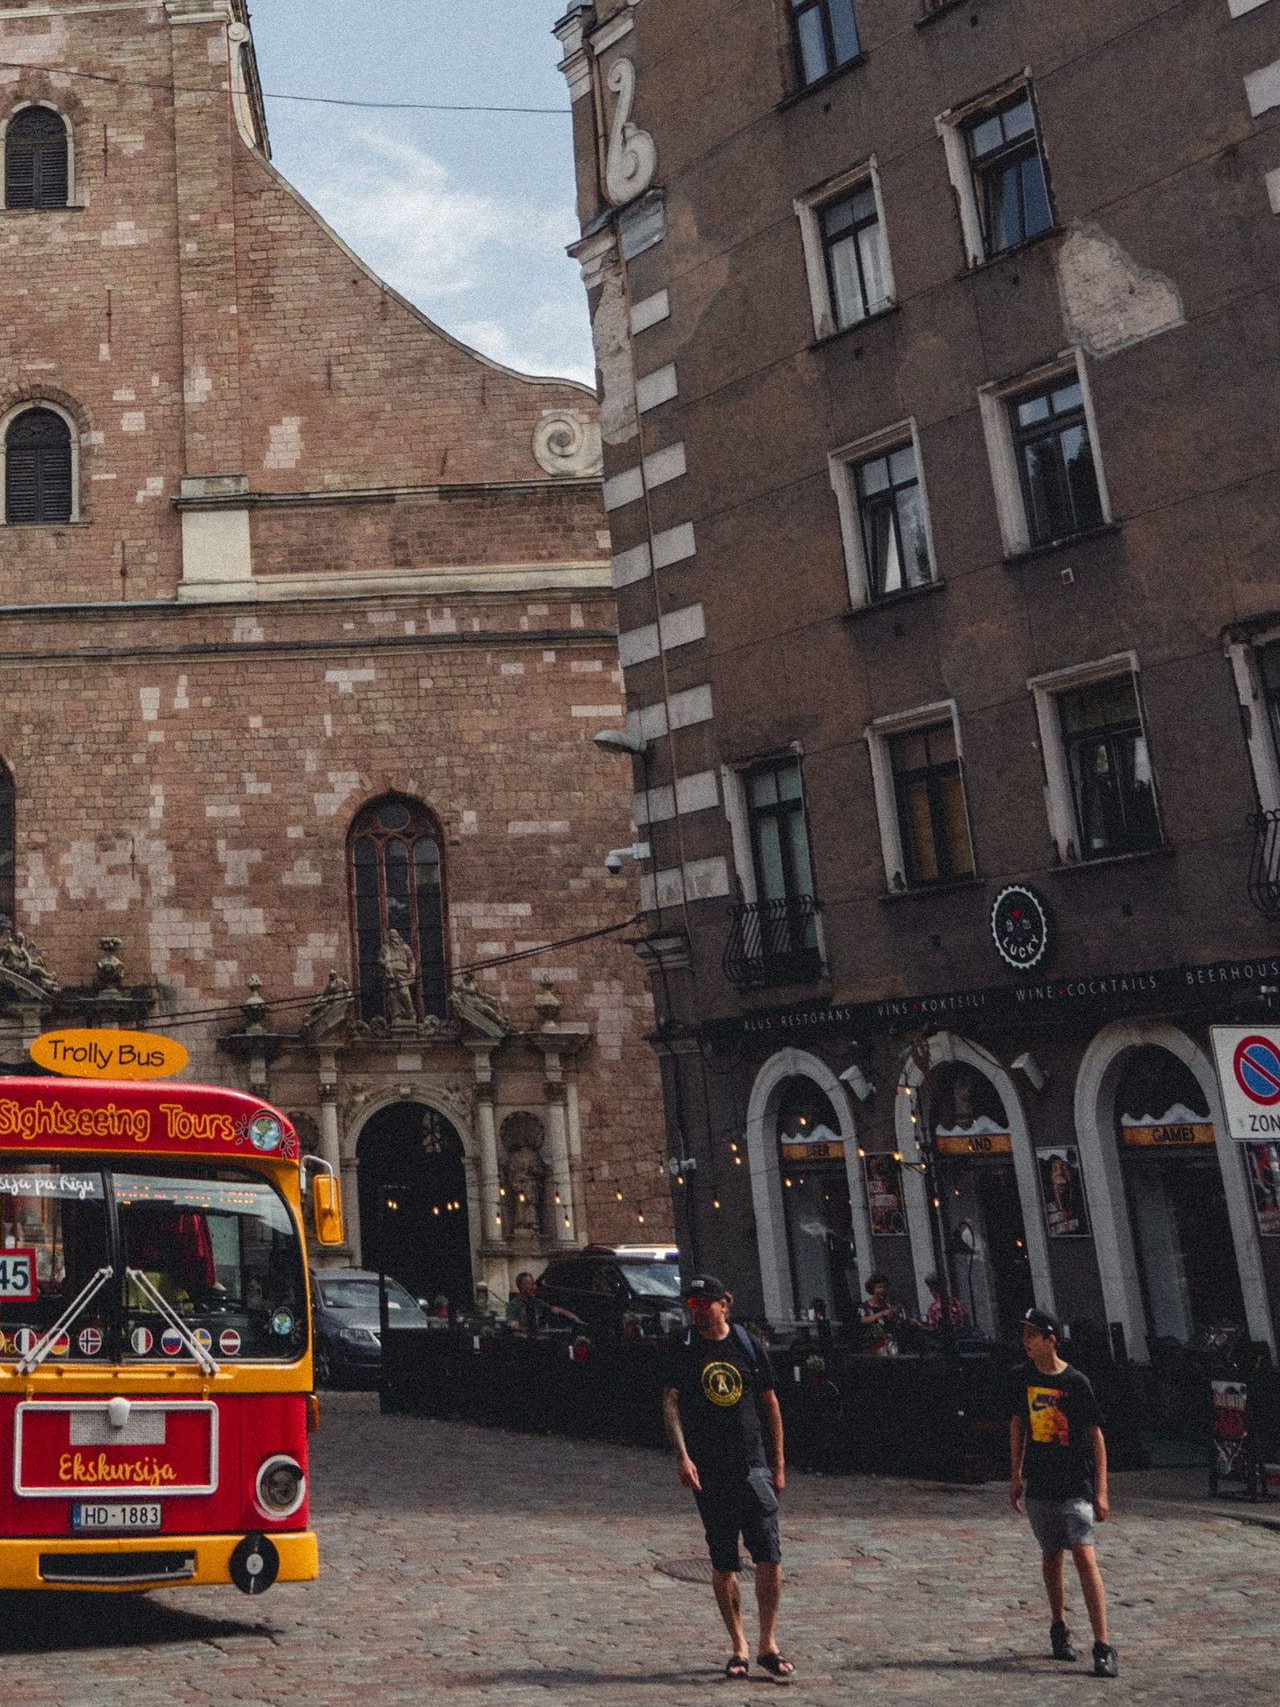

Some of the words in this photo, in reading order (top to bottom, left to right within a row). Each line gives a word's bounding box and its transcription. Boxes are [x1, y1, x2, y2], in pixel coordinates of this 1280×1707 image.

[1002, 934, 1039, 958] LUCKY
[1015, 986, 1053, 1002] WINE
[1066, 975, 1157, 997] COCKTAILS
[48, 1039, 113, 1070] Trolly
[118, 1044, 165, 1067] Bus
[159, 1104, 236, 1141] Tours
[1152, 1126, 1195, 1142] GAMES
[970, 1137, 992, 1152] AND
[35, 1178, 56, 1194] pa
[58, 1452, 178, 1488] Ekskursija
